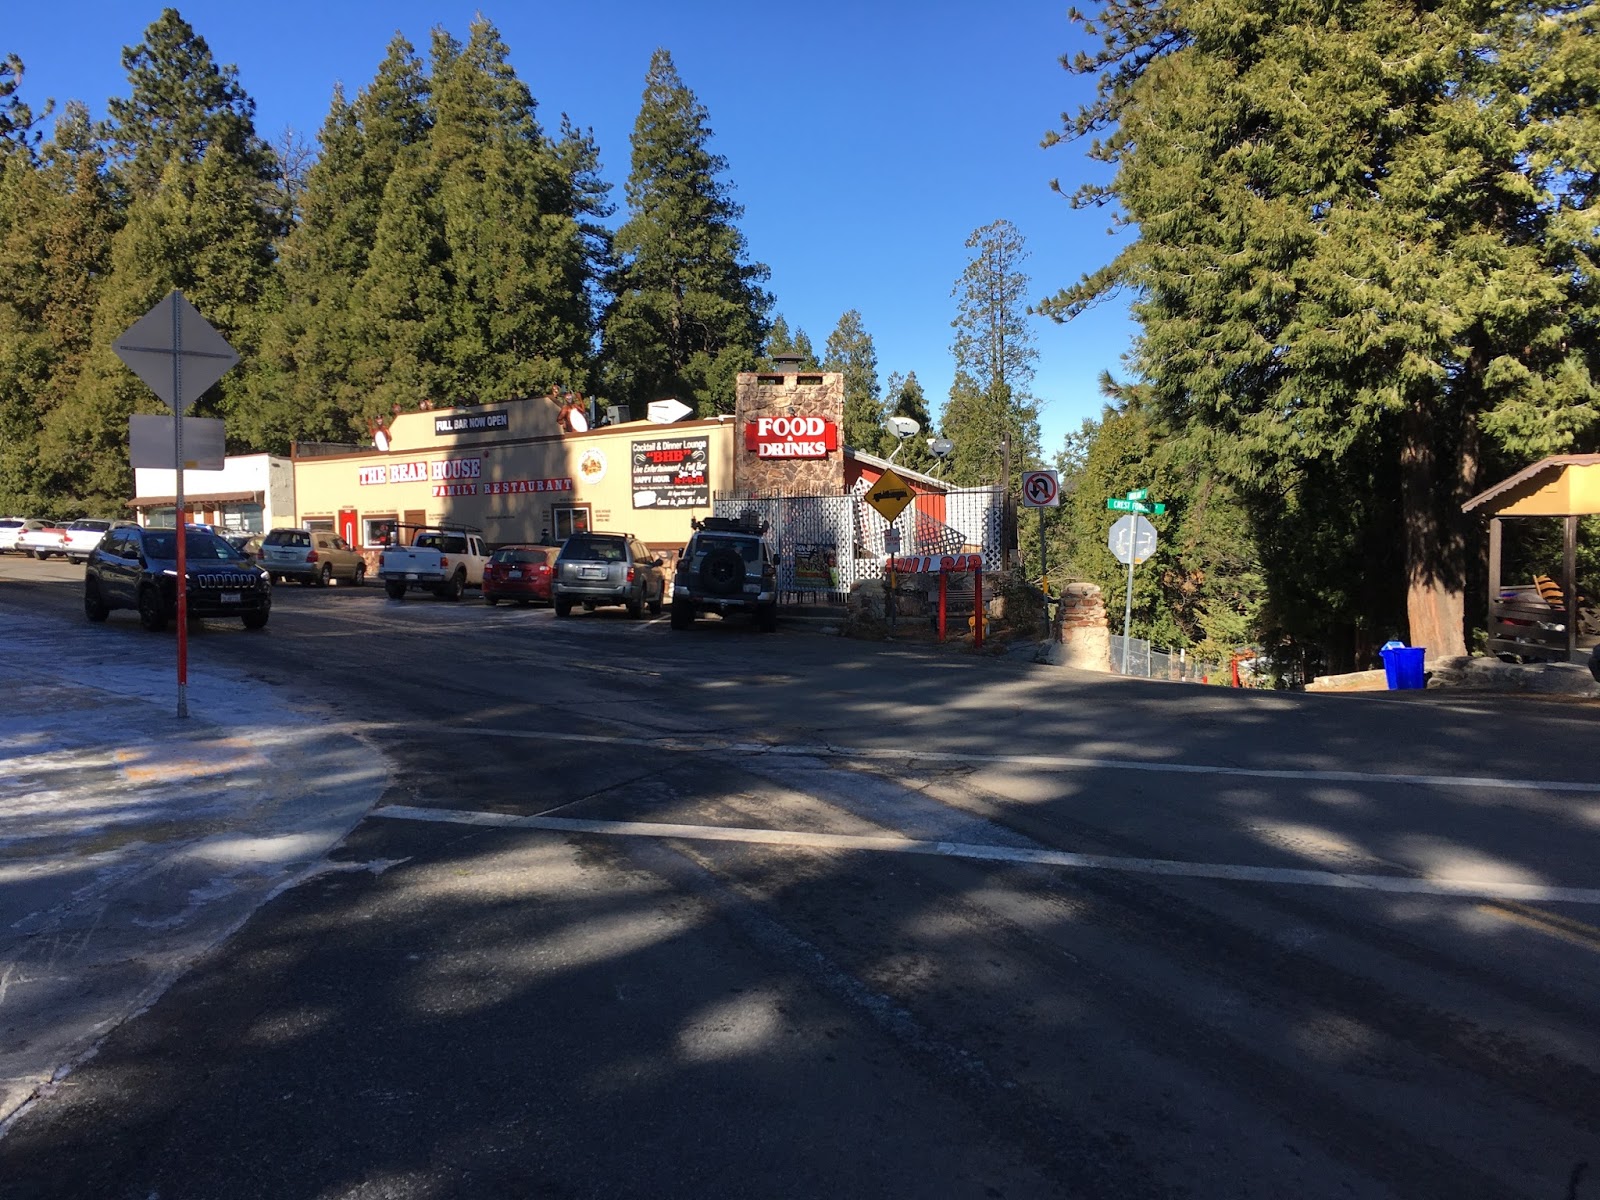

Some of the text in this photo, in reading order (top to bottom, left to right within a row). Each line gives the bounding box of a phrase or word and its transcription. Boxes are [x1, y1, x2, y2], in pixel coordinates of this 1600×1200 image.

[436, 415, 507, 431] FULL BAR NOW OPEN
[757, 417, 826, 436] FOOD
[632, 440, 707, 452] Cocktail & Dinner Lounge
[758, 441, 827, 456] DRINKS
[359, 459, 481, 485] THE BEAR HOUSE
[633, 465, 643, 473] Live
[652, 475, 670, 483] HOUR
[432, 479, 572, 497] FAMILY RESTAURANT
[1113, 500, 1130, 509] CREST
